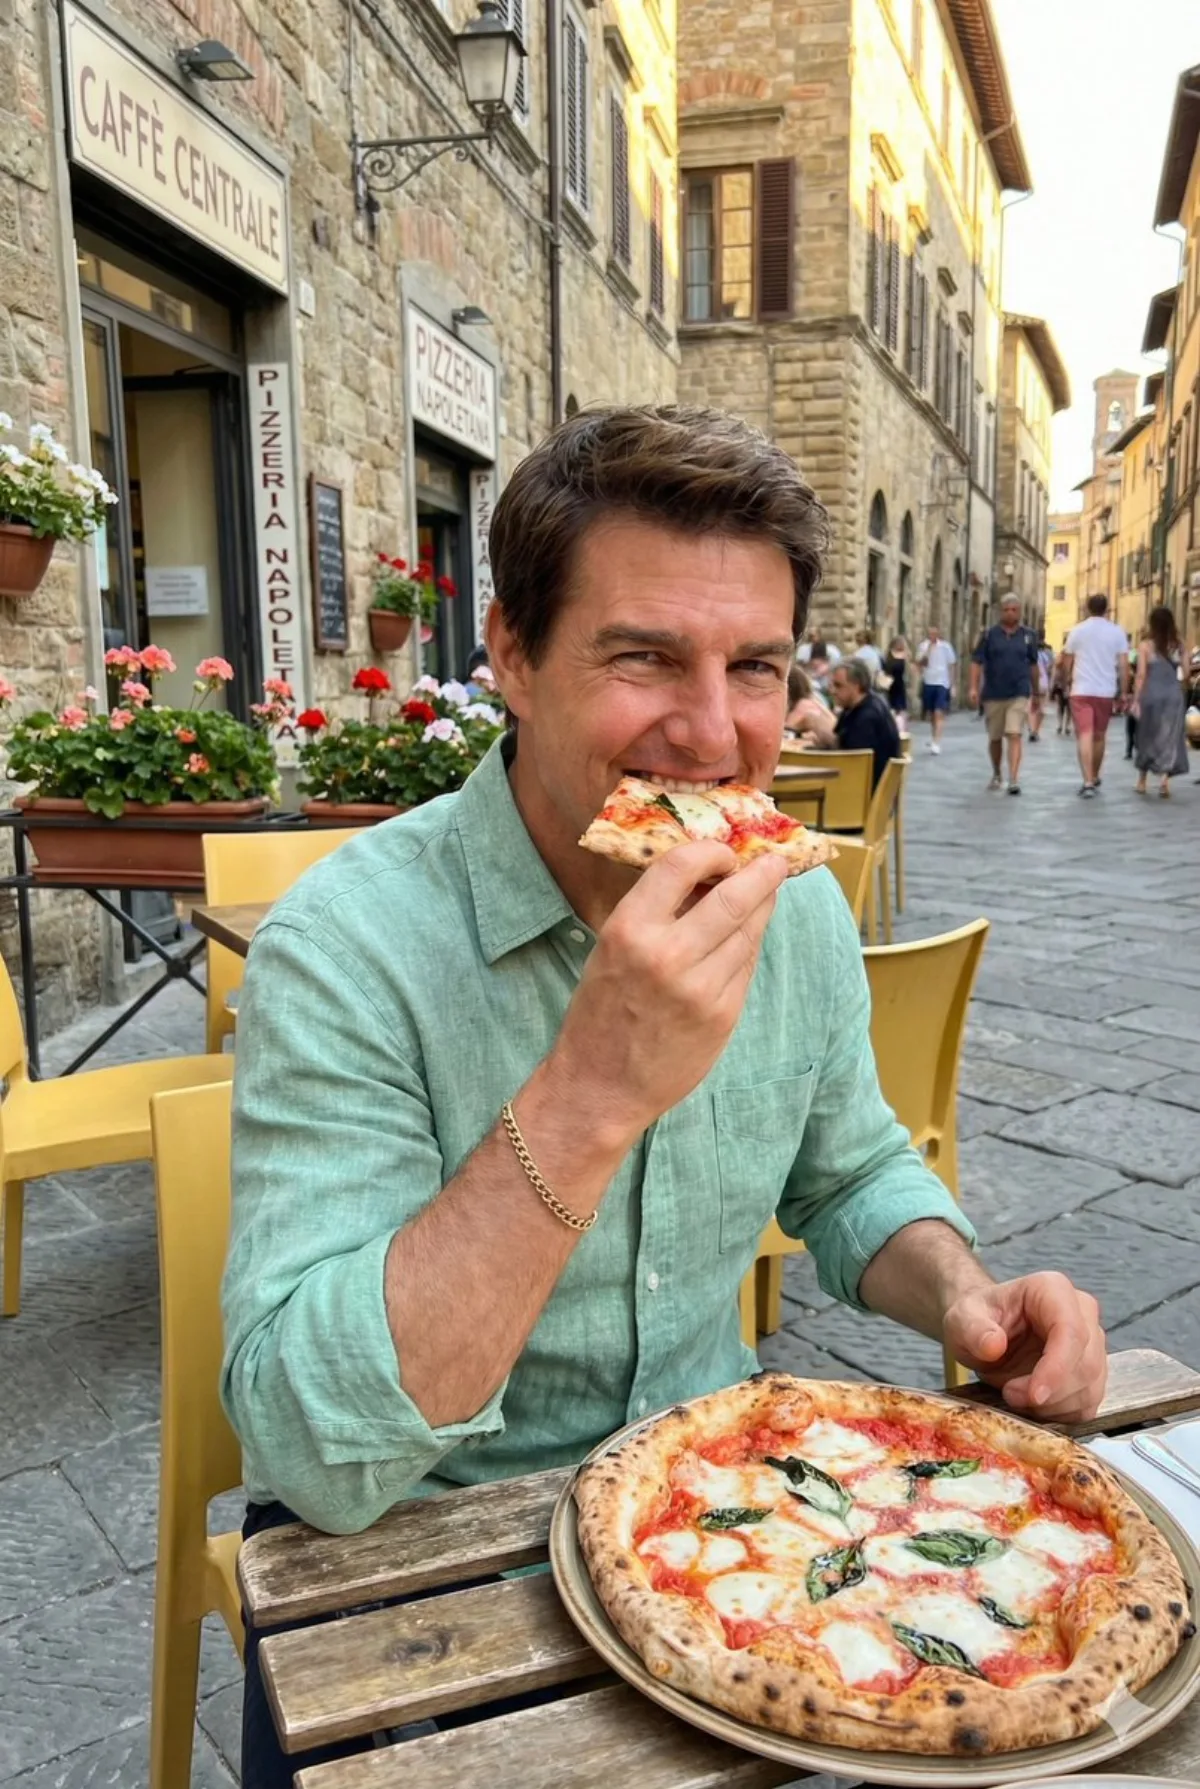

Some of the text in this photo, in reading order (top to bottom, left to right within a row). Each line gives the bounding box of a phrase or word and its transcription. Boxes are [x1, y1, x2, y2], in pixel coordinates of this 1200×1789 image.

[80, 65, 280, 262] CAFFÈ CENTRALE
[416, 324, 489, 414] PIZZERIA
[258, 370, 298, 740] PIZZERIA NAPOLETA
